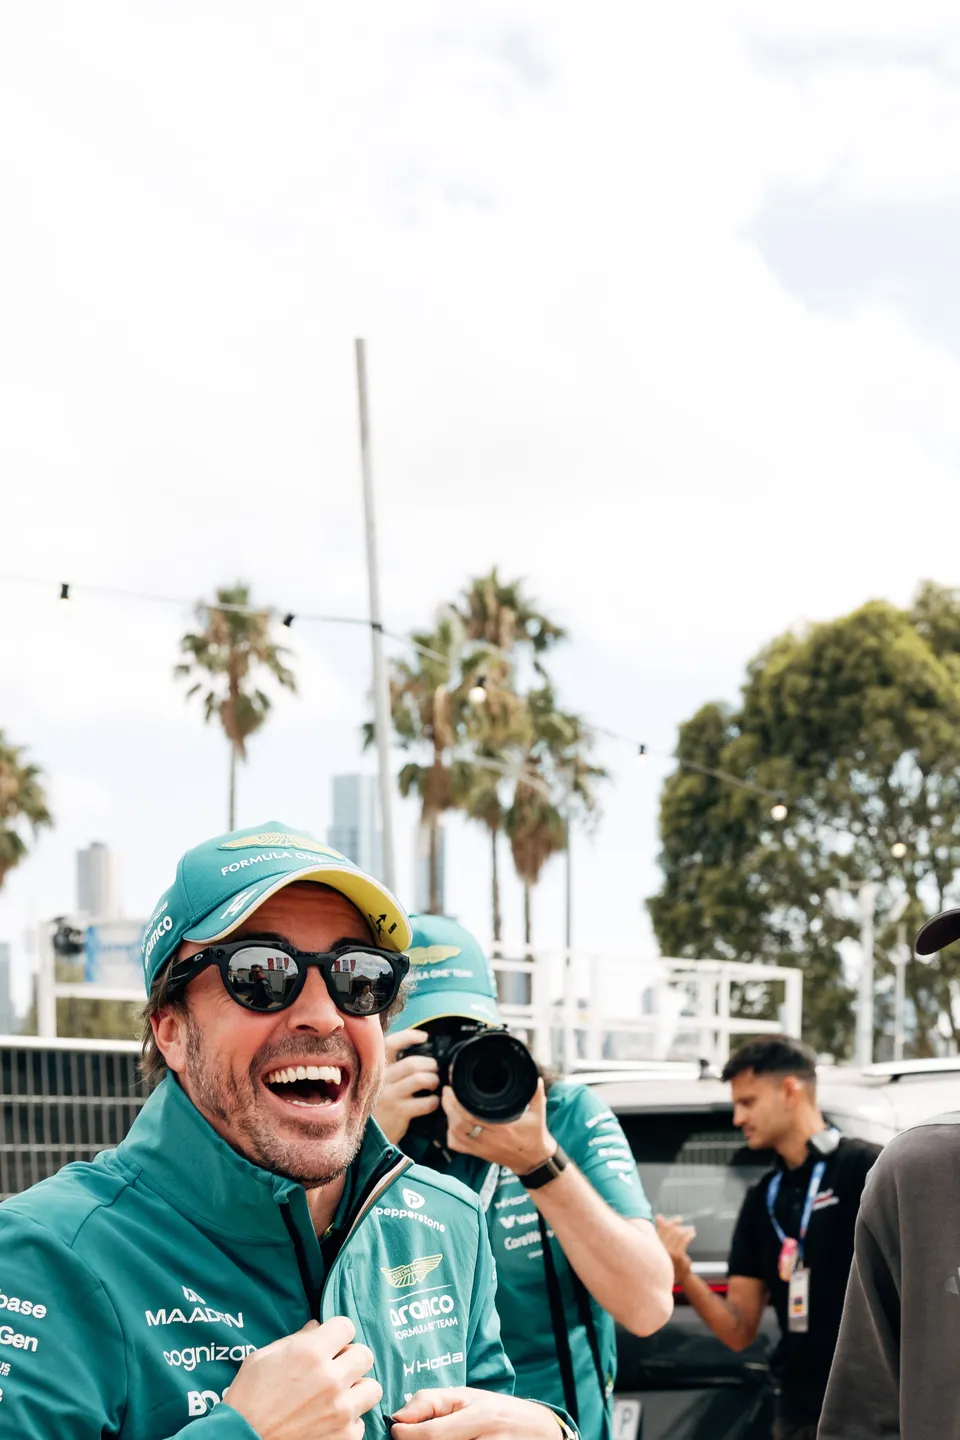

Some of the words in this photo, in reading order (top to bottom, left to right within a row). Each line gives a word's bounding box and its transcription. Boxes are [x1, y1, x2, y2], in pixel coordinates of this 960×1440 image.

[220, 851, 292, 876] FORMULA
[375, 1207, 446, 1233] pepperstone
[417, 1351, 464, 1373] Hoda
